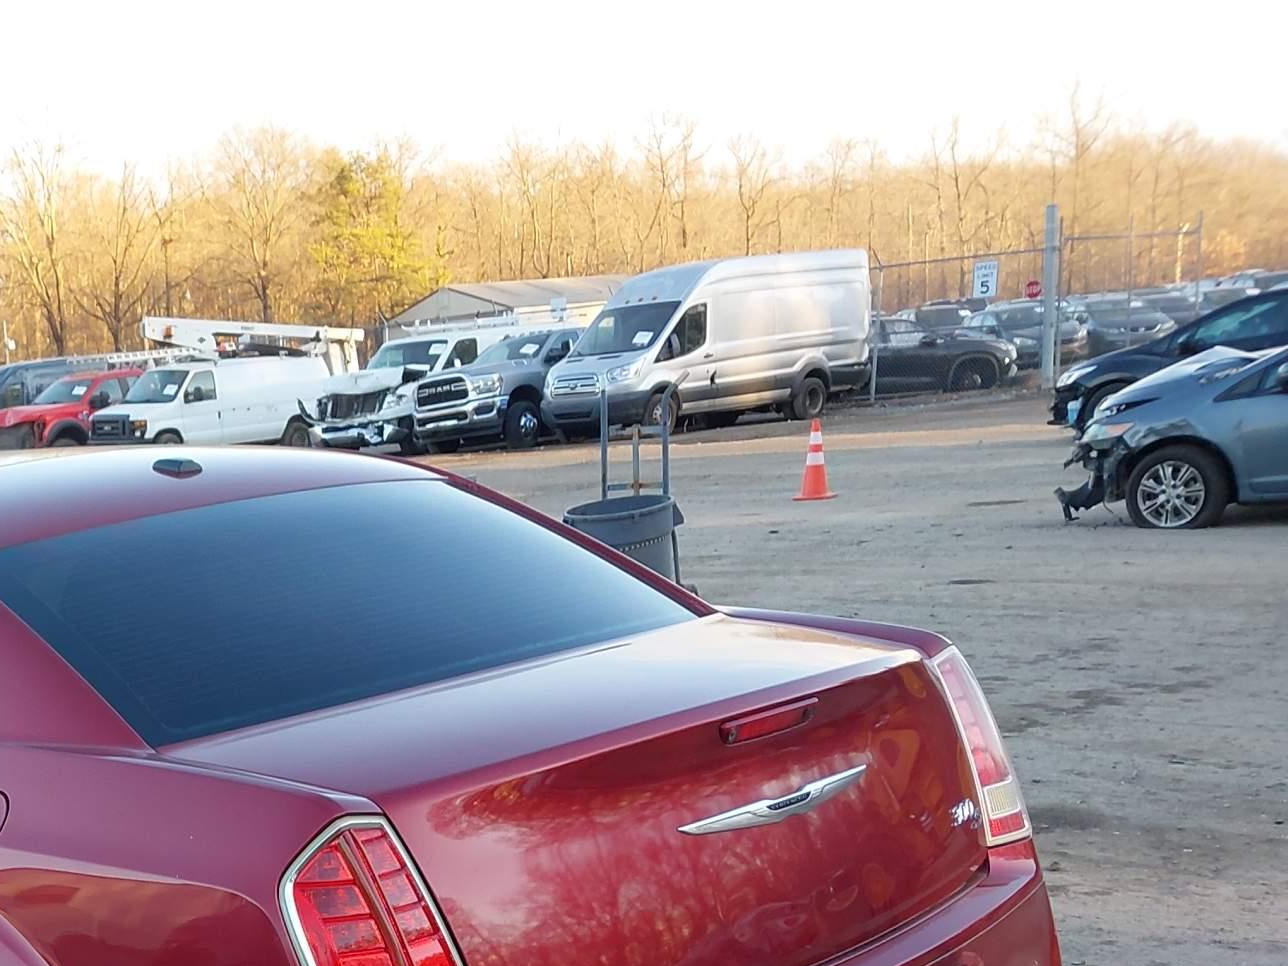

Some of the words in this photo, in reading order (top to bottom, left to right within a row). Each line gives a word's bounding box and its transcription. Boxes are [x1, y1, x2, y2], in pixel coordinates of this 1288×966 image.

[976, 263, 997, 271] SPEED
[976, 271, 994, 279] LIMIT
[979, 280, 990, 294] 5
[429, 384, 451, 395] RAM
